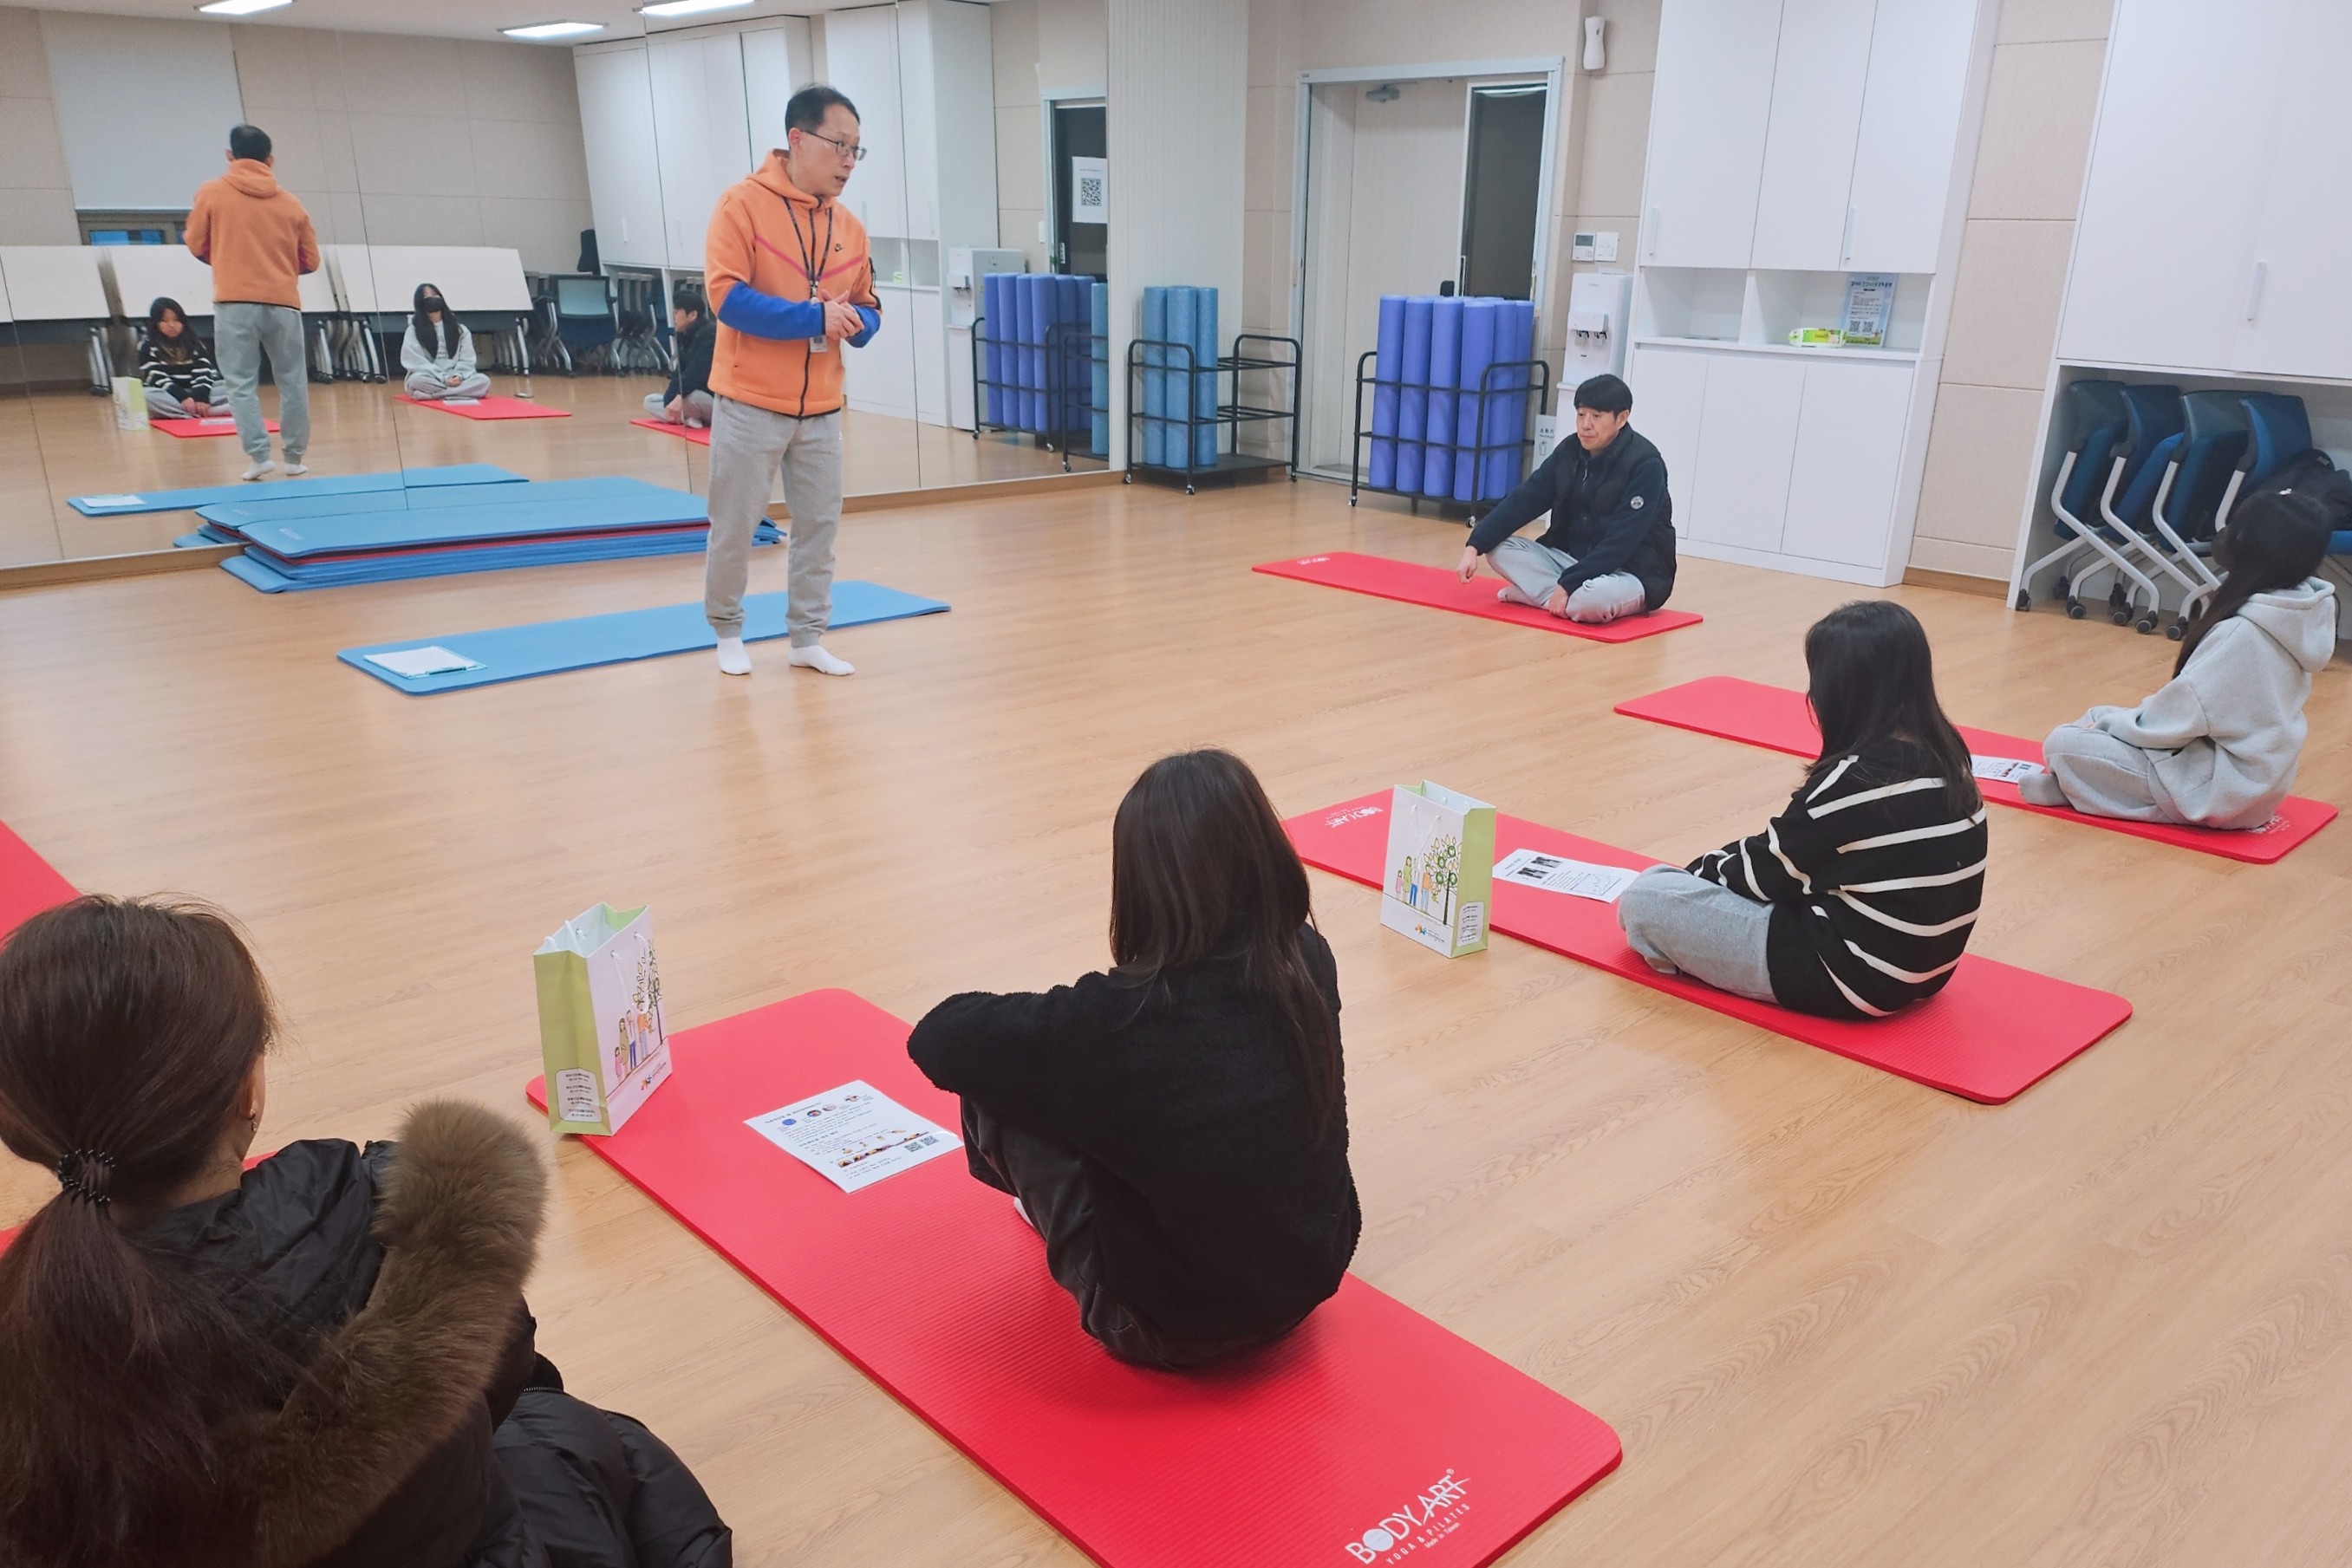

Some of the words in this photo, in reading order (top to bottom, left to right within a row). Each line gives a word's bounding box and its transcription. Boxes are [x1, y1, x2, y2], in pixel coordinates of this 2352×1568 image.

[1345, 1505, 1422, 1565] BODY
[1385, 1543, 1417, 1565] YOGA
[1417, 1535, 1426, 1544] &
[1426, 1502, 1470, 1536] PILATES
